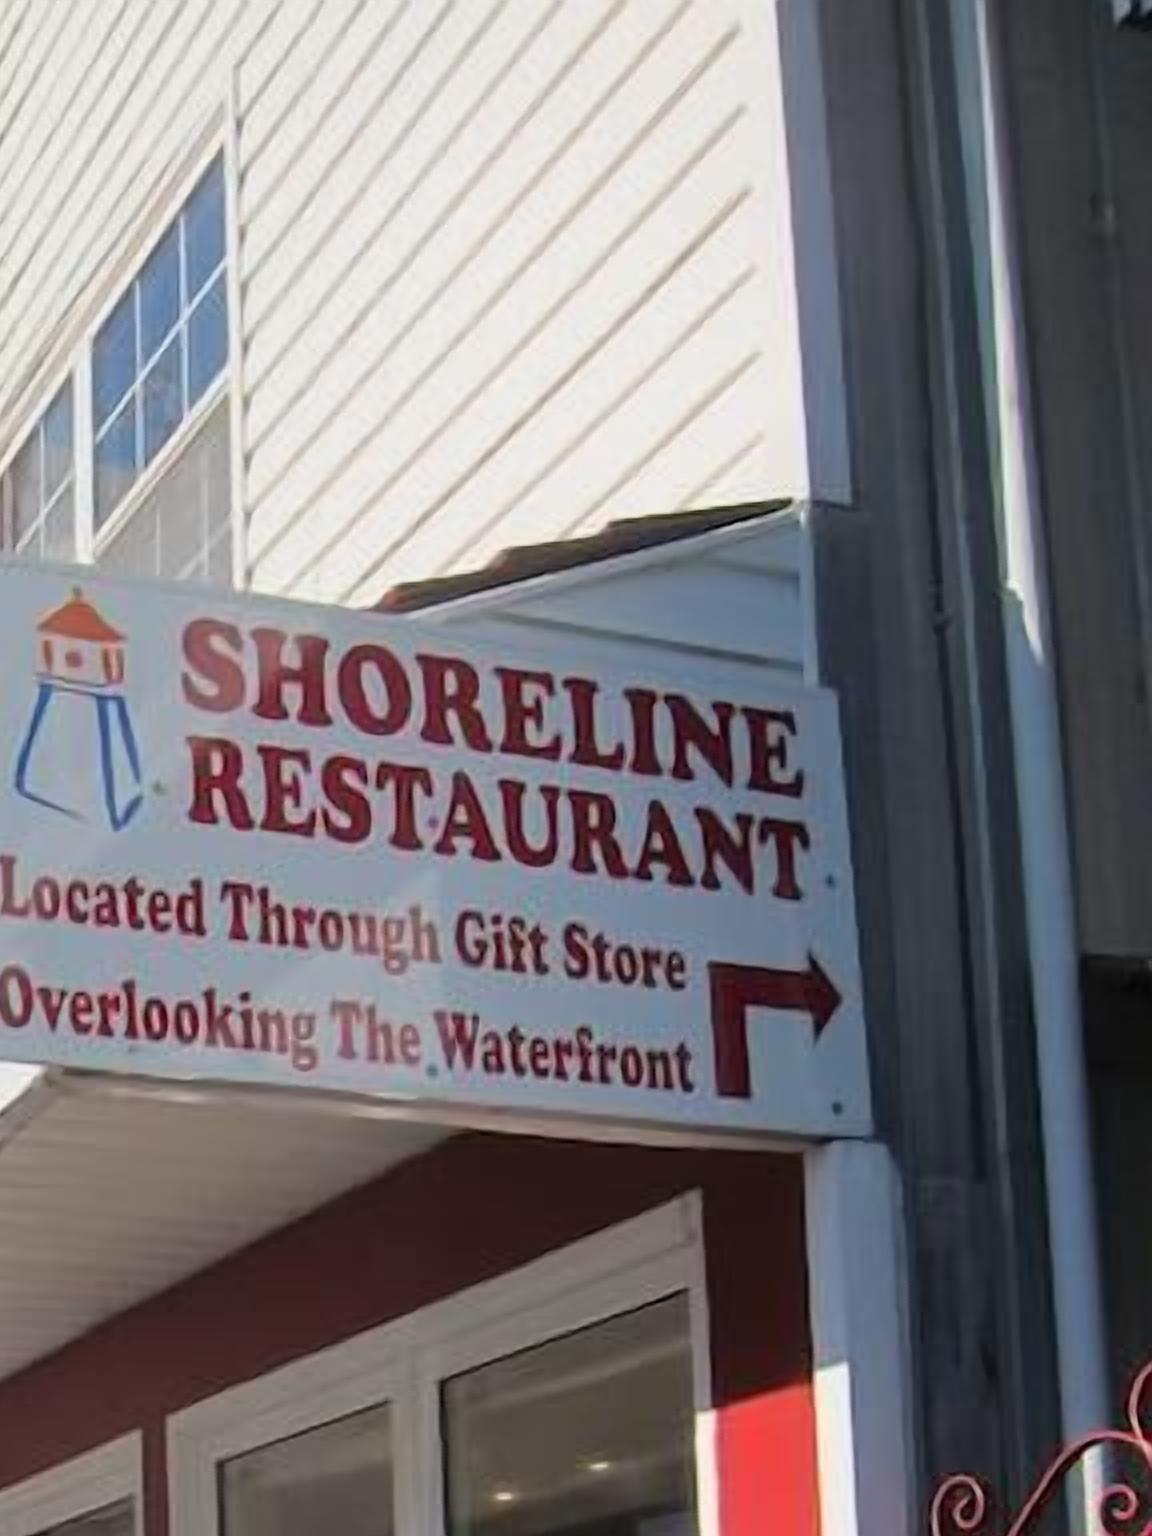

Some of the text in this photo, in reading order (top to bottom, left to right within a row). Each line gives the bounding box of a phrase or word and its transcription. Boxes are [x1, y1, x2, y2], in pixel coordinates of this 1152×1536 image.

[182, 618, 805, 798] SHORELINE
[188, 735, 809, 902] RESTAURANT
[221, 881, 440, 975] Through
[456, 911, 549, 975] Gift
[564, 922, 687, 989] Store
[330, 1000, 420, 1061] The
[434, 1011, 693, 1092] Waterfront
